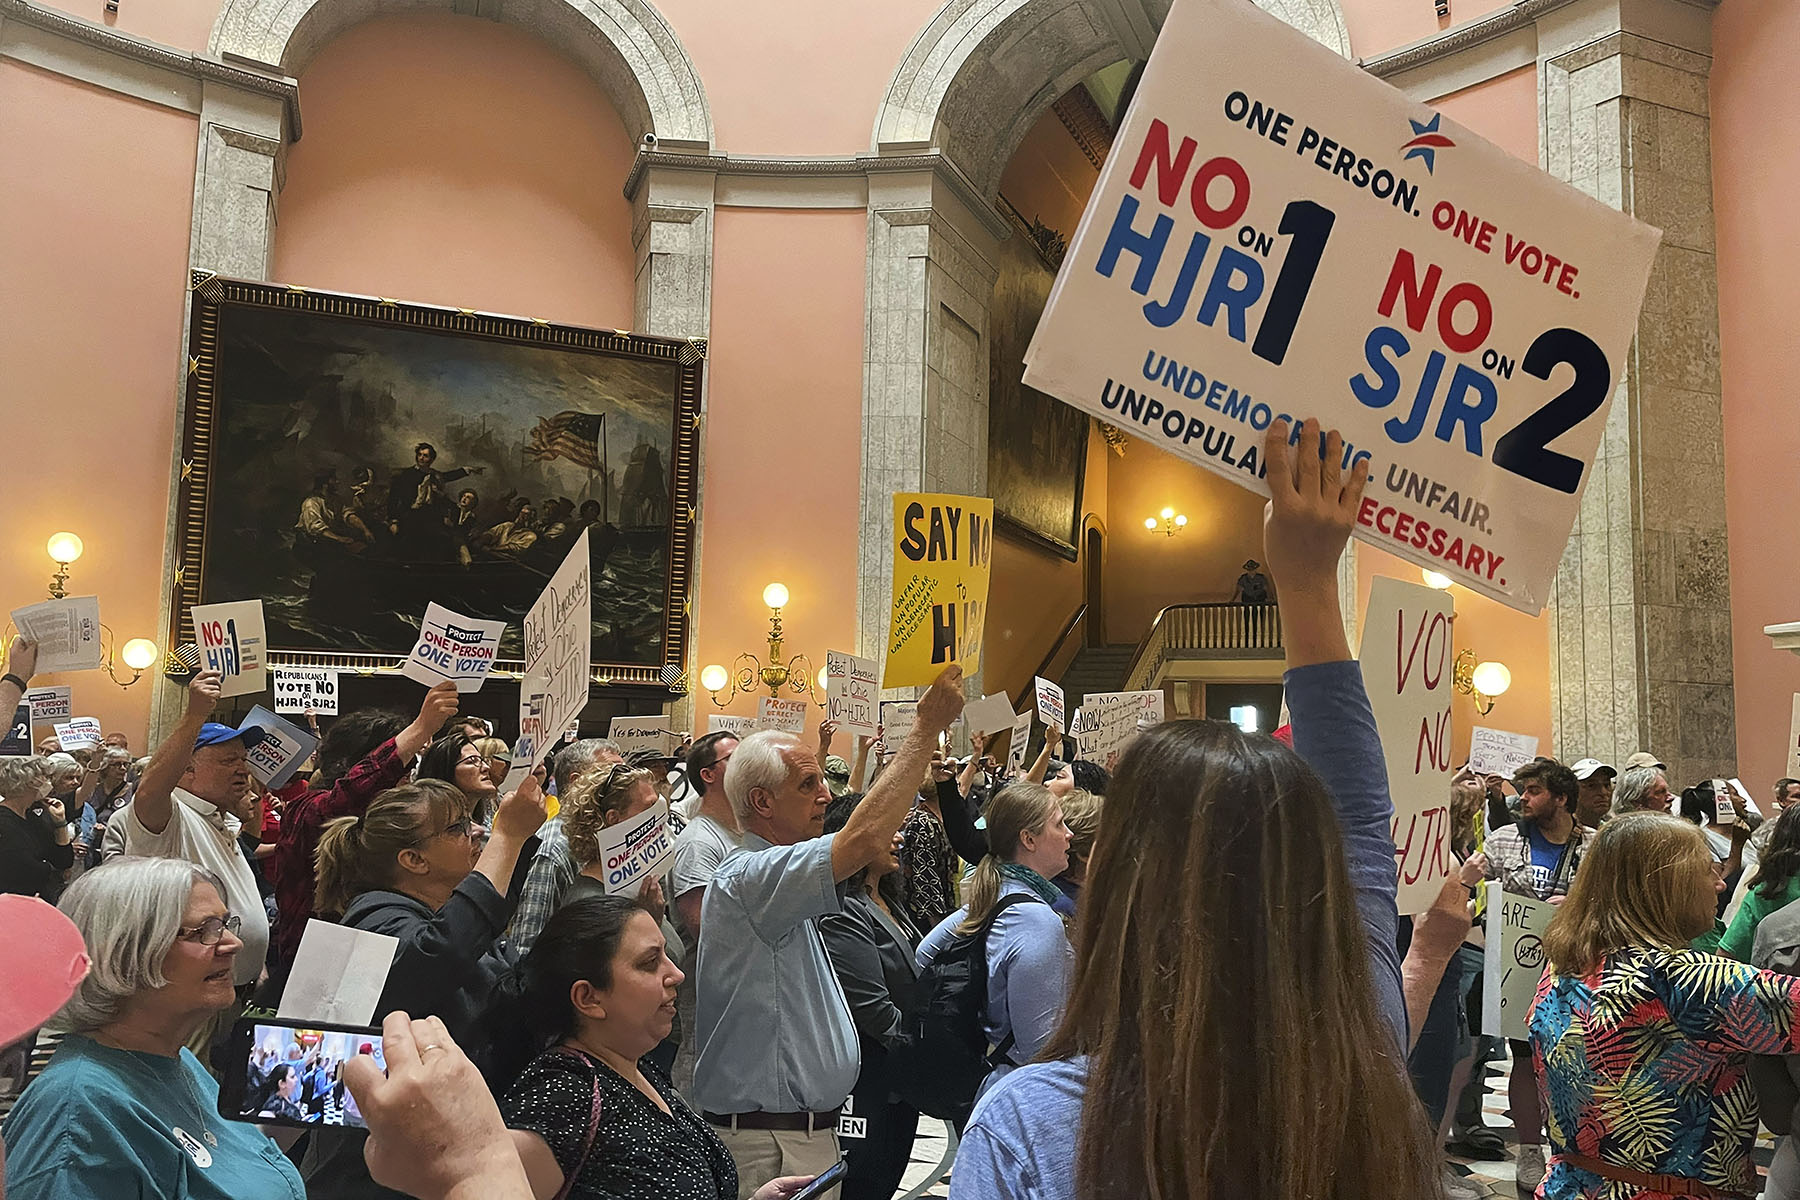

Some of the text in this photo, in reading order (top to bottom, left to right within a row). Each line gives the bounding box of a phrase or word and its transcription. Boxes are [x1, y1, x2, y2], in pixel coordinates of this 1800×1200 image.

[1129, 118, 1274, 258] NO ON
[1224, 91, 1581, 300] ONE PERSON. ONE VOTE.
[1377, 247, 1515, 380] NO ON
[1099, 379, 1507, 587] UNPOPULA ECESSARY.
[1385, 462, 1494, 536] UNFAIR.
[900, 501, 990, 568] SAY NO
[956, 576, 966, 600] to
[201, 620, 223, 647] NO
[424, 630, 493, 659] ONE PERSON
[448, 628, 482, 642] PROTECT
[417, 643, 489, 674] ONE VOTE
[277, 681, 335, 695] VOTE NO
[42, 707, 69, 715] VOTE
[765, 698, 807, 712] PROTECT
[828, 697, 841, 720] NO
[1138, 694, 1157, 708] OP
[718, 718, 740, 729] WHY
[1079, 709, 1101, 732] NOW
[250, 748, 280, 771] VOTE
[607, 848, 632, 870] ONE
[609, 833, 669, 885] ONE VOTE
[1501, 901, 1536, 930] ARE
[841, 1119, 863, 1135] EN
